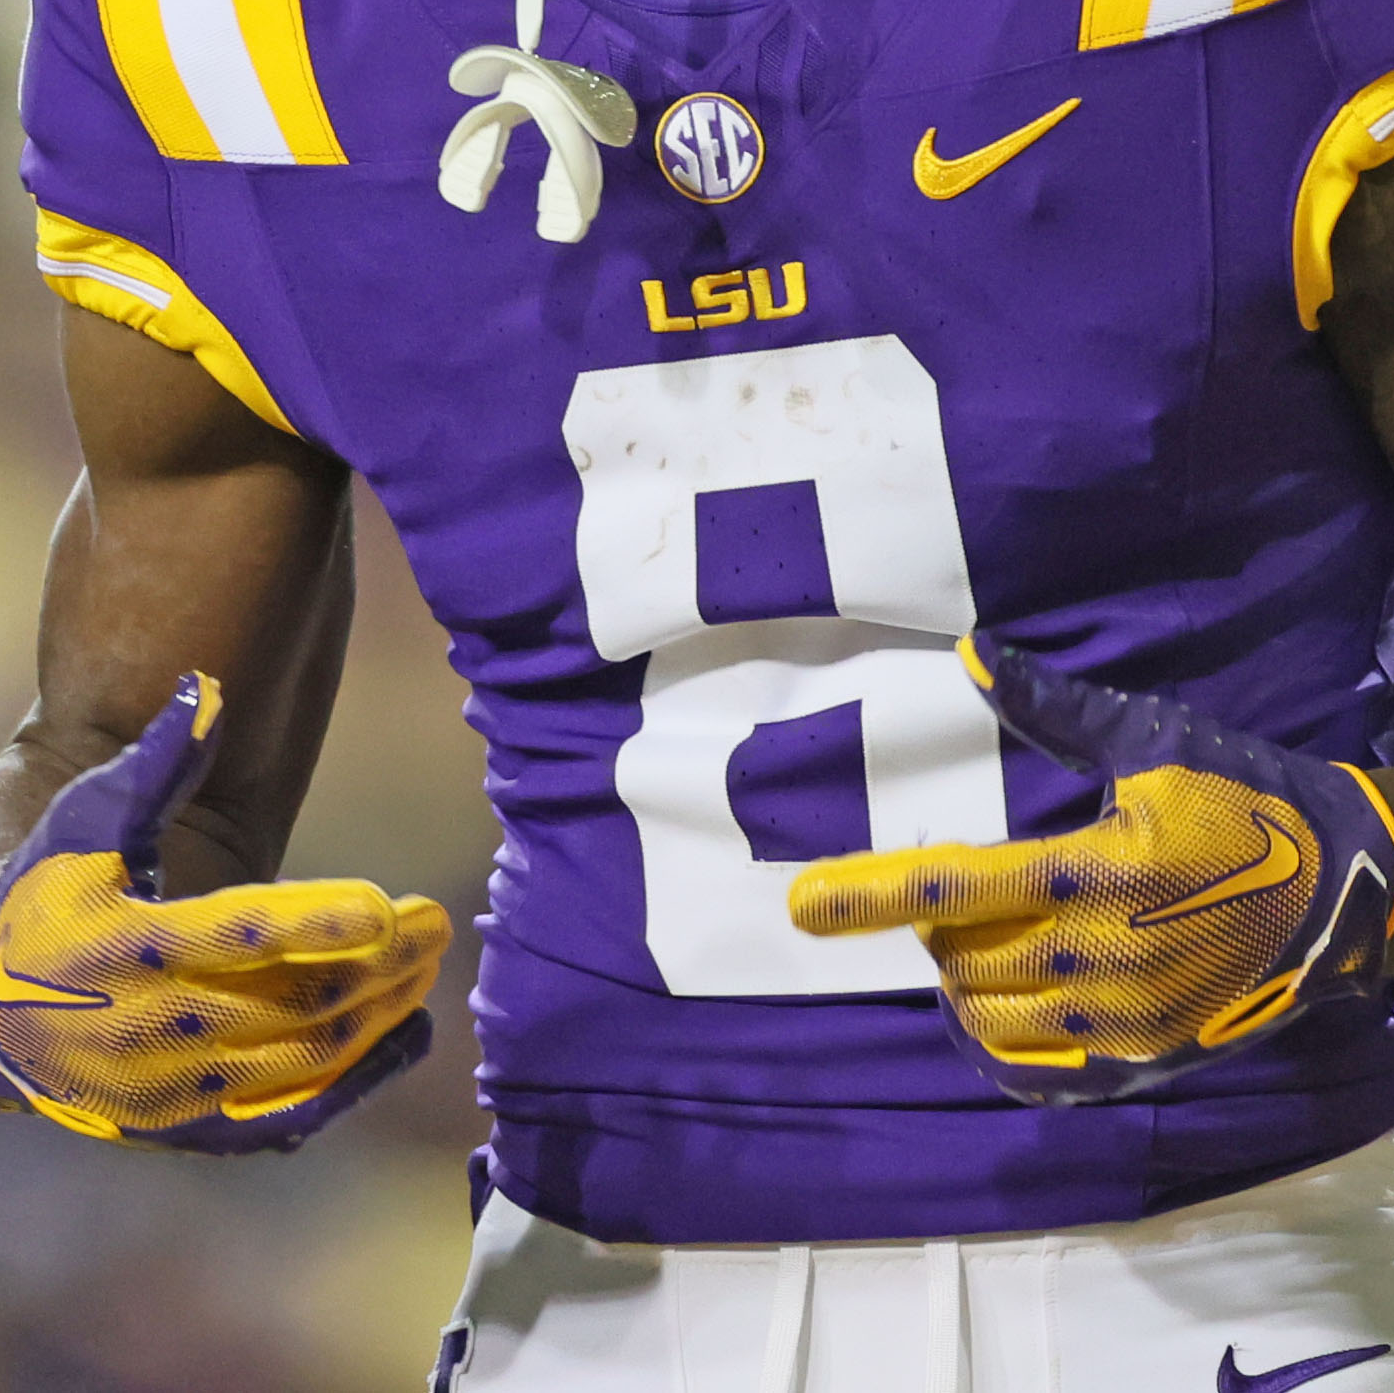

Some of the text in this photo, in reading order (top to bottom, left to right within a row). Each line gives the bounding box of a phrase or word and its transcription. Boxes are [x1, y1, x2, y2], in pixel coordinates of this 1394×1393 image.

[664, 101, 755, 197] SEC
[639, 260, 808, 333] LSU
[562, 334, 1009, 997] 8
